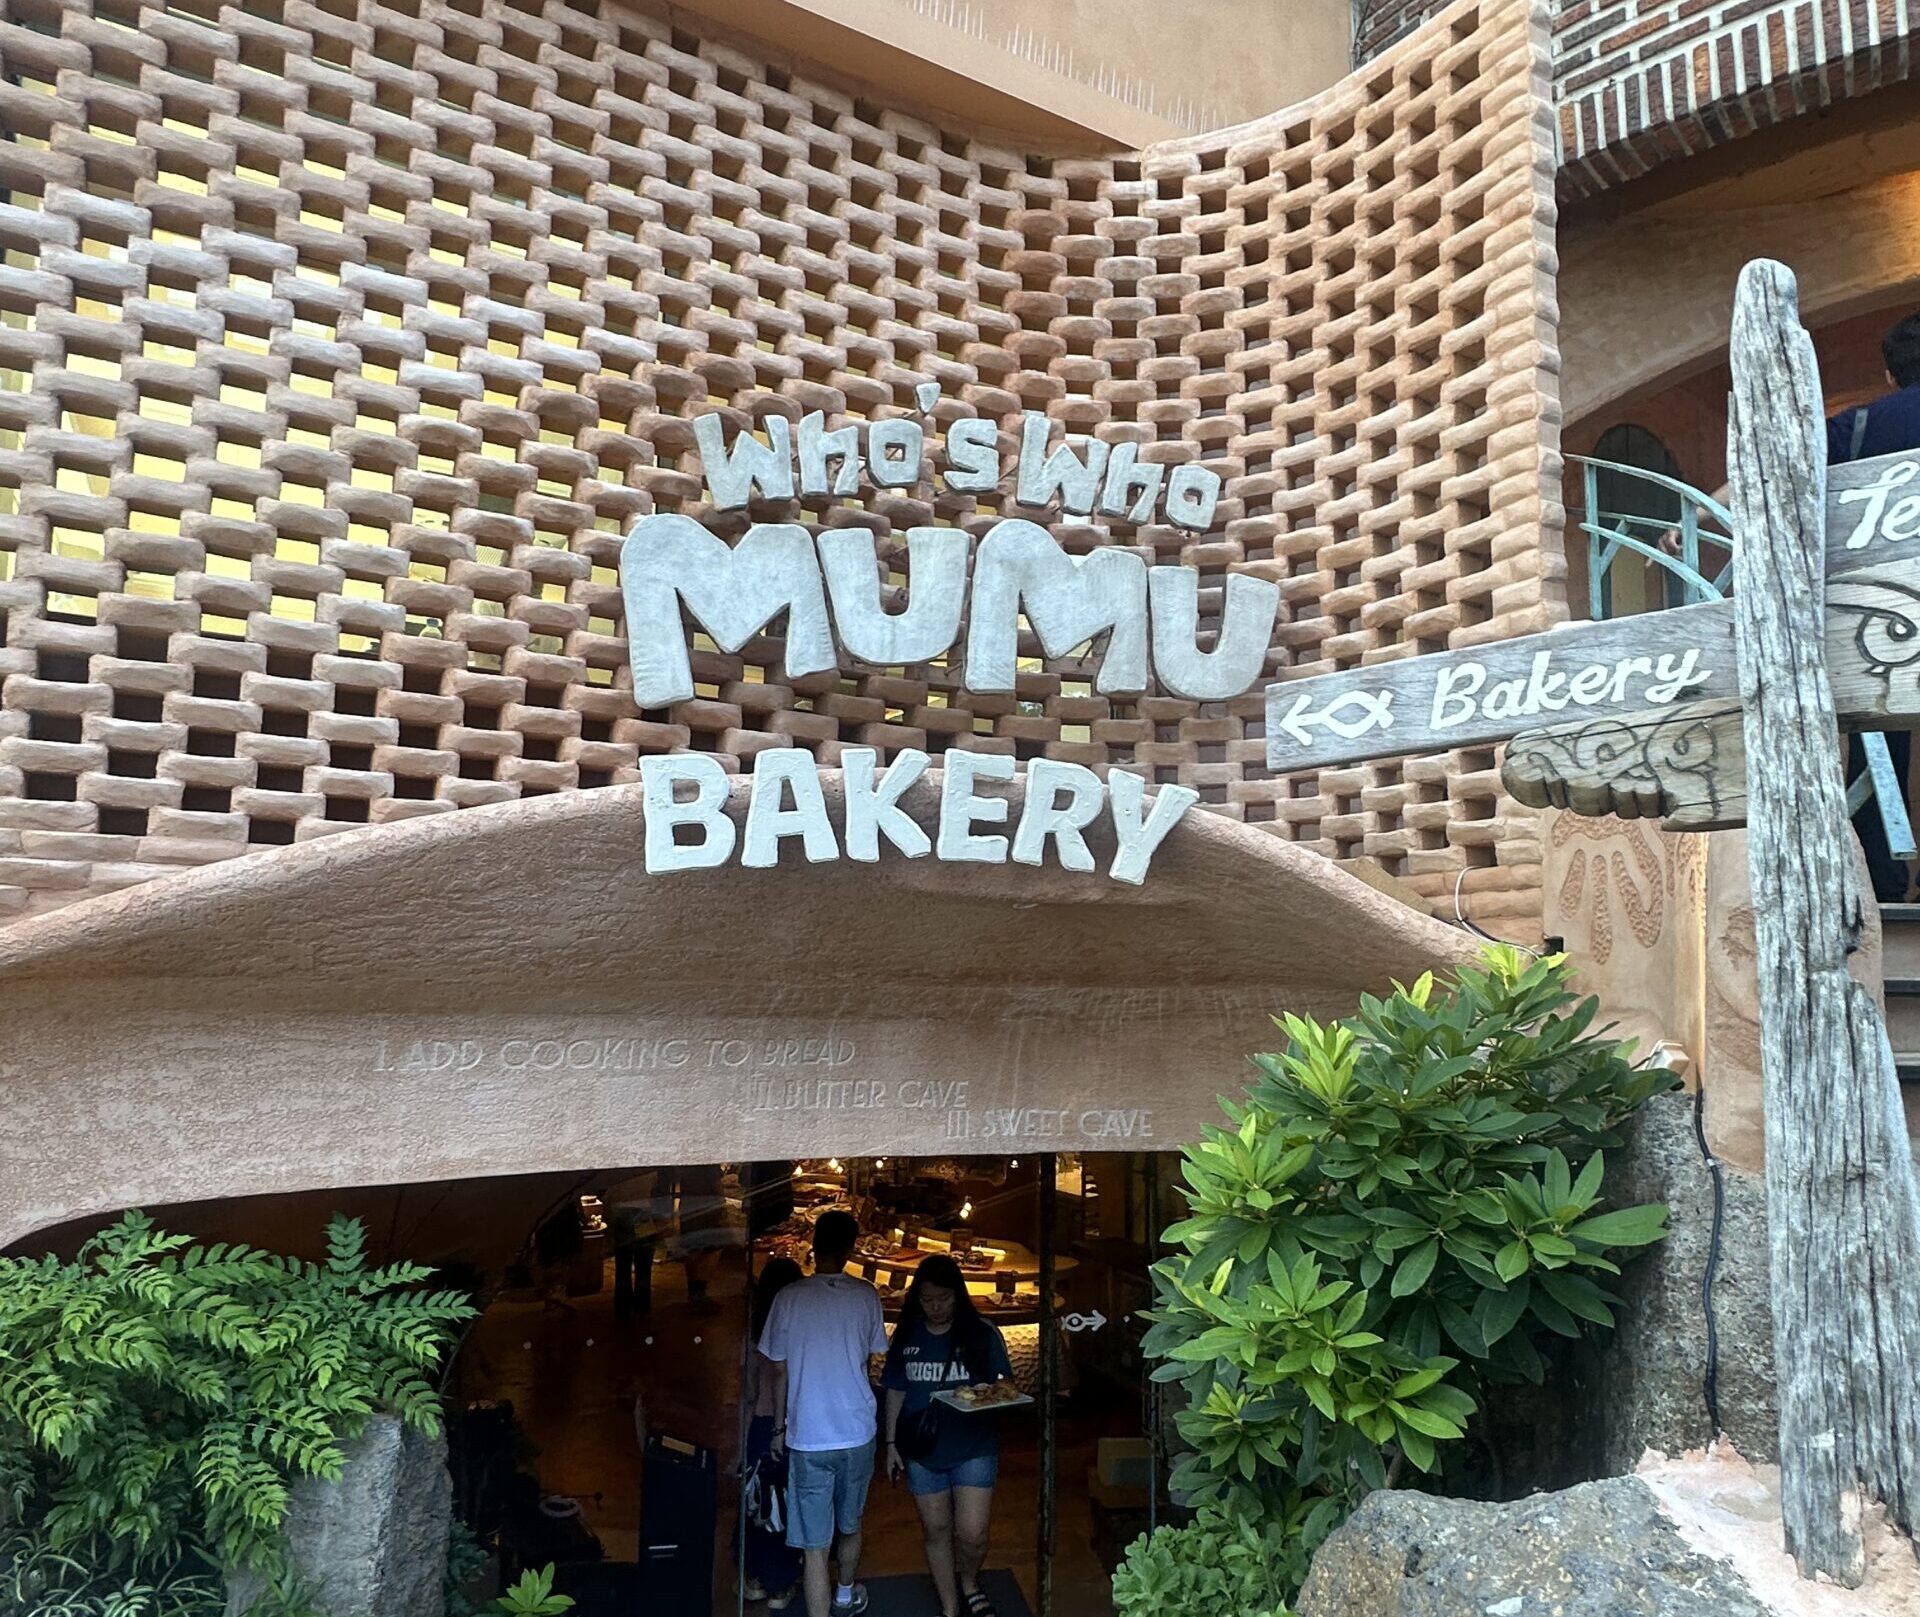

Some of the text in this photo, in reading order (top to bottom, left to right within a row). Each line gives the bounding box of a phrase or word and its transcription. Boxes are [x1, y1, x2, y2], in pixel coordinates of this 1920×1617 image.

[694, 383, 1221, 530] Who's Who
[1838, 460, 1920, 550] Te
[620, 513, 1281, 711] MUMU
[1430, 647, 1713, 732] Bakery
[639, 747, 1200, 886] BAKERY
[400, 1041, 483, 1071] ADD
[501, 1040, 690, 1070] COOKING
[703, 1039, 752, 1067] TO
[763, 1038, 856, 1067] BREAD
[783, 1079, 887, 1109] BUTTER
[898, 1080, 970, 1109] CAVE
[983, 1108, 1070, 1137] SWEET
[1079, 1110, 1154, 1137] CAVE
